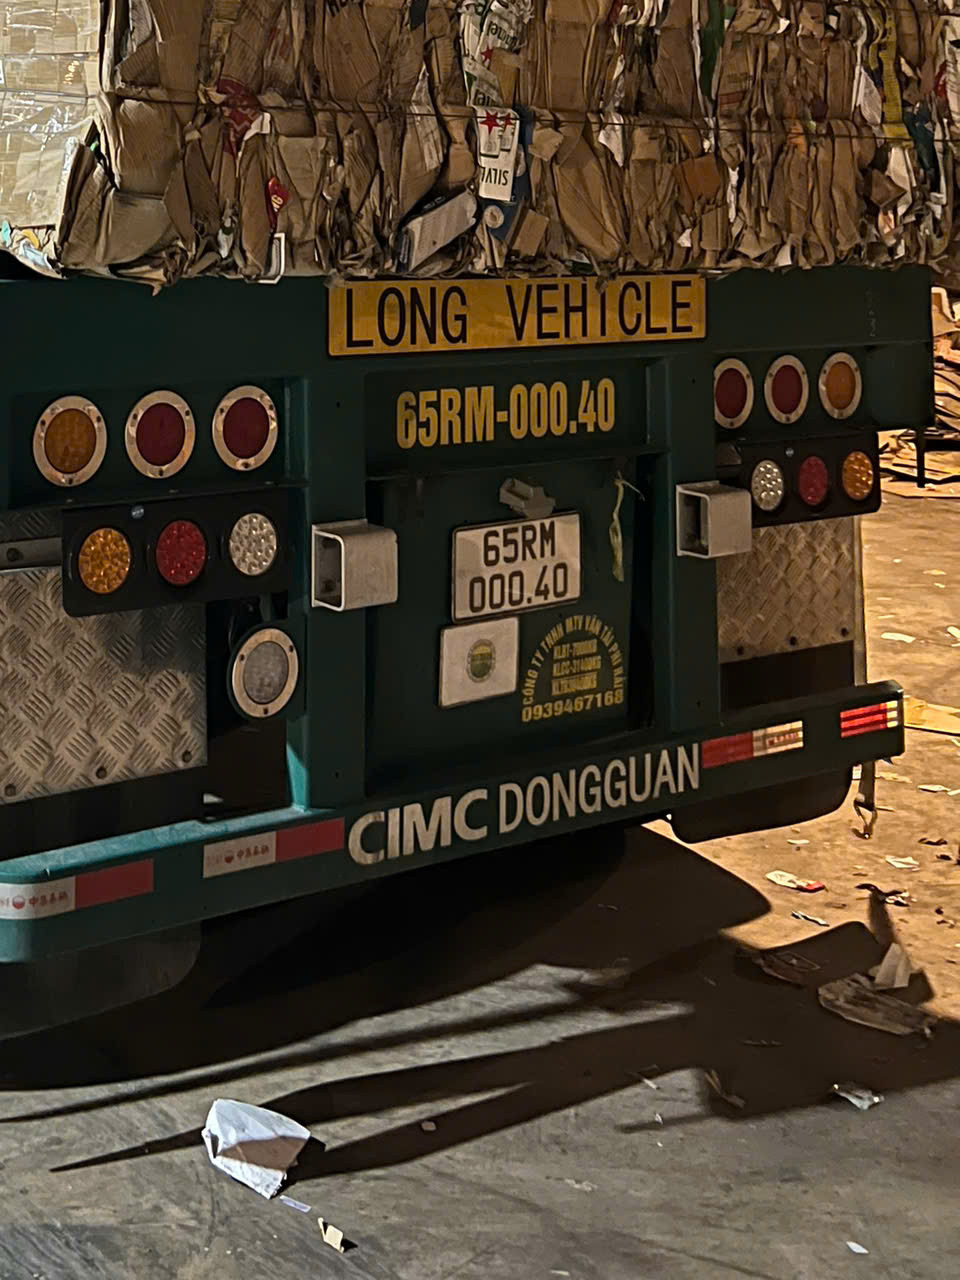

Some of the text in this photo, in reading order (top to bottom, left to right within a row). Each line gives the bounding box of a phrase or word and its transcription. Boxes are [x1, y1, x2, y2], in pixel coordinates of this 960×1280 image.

[346, 280, 694, 348] LONG VEHICLE
[396, 378, 616, 450] 65RM-000.40
[483, 520, 556, 567] 65RM
[469, 562, 569, 613] 000.40
[531, 649, 545, 668] TY
[521, 688, 624, 723] 0939467168
[348, 742, 700, 865] CIMC DONGGUAN
